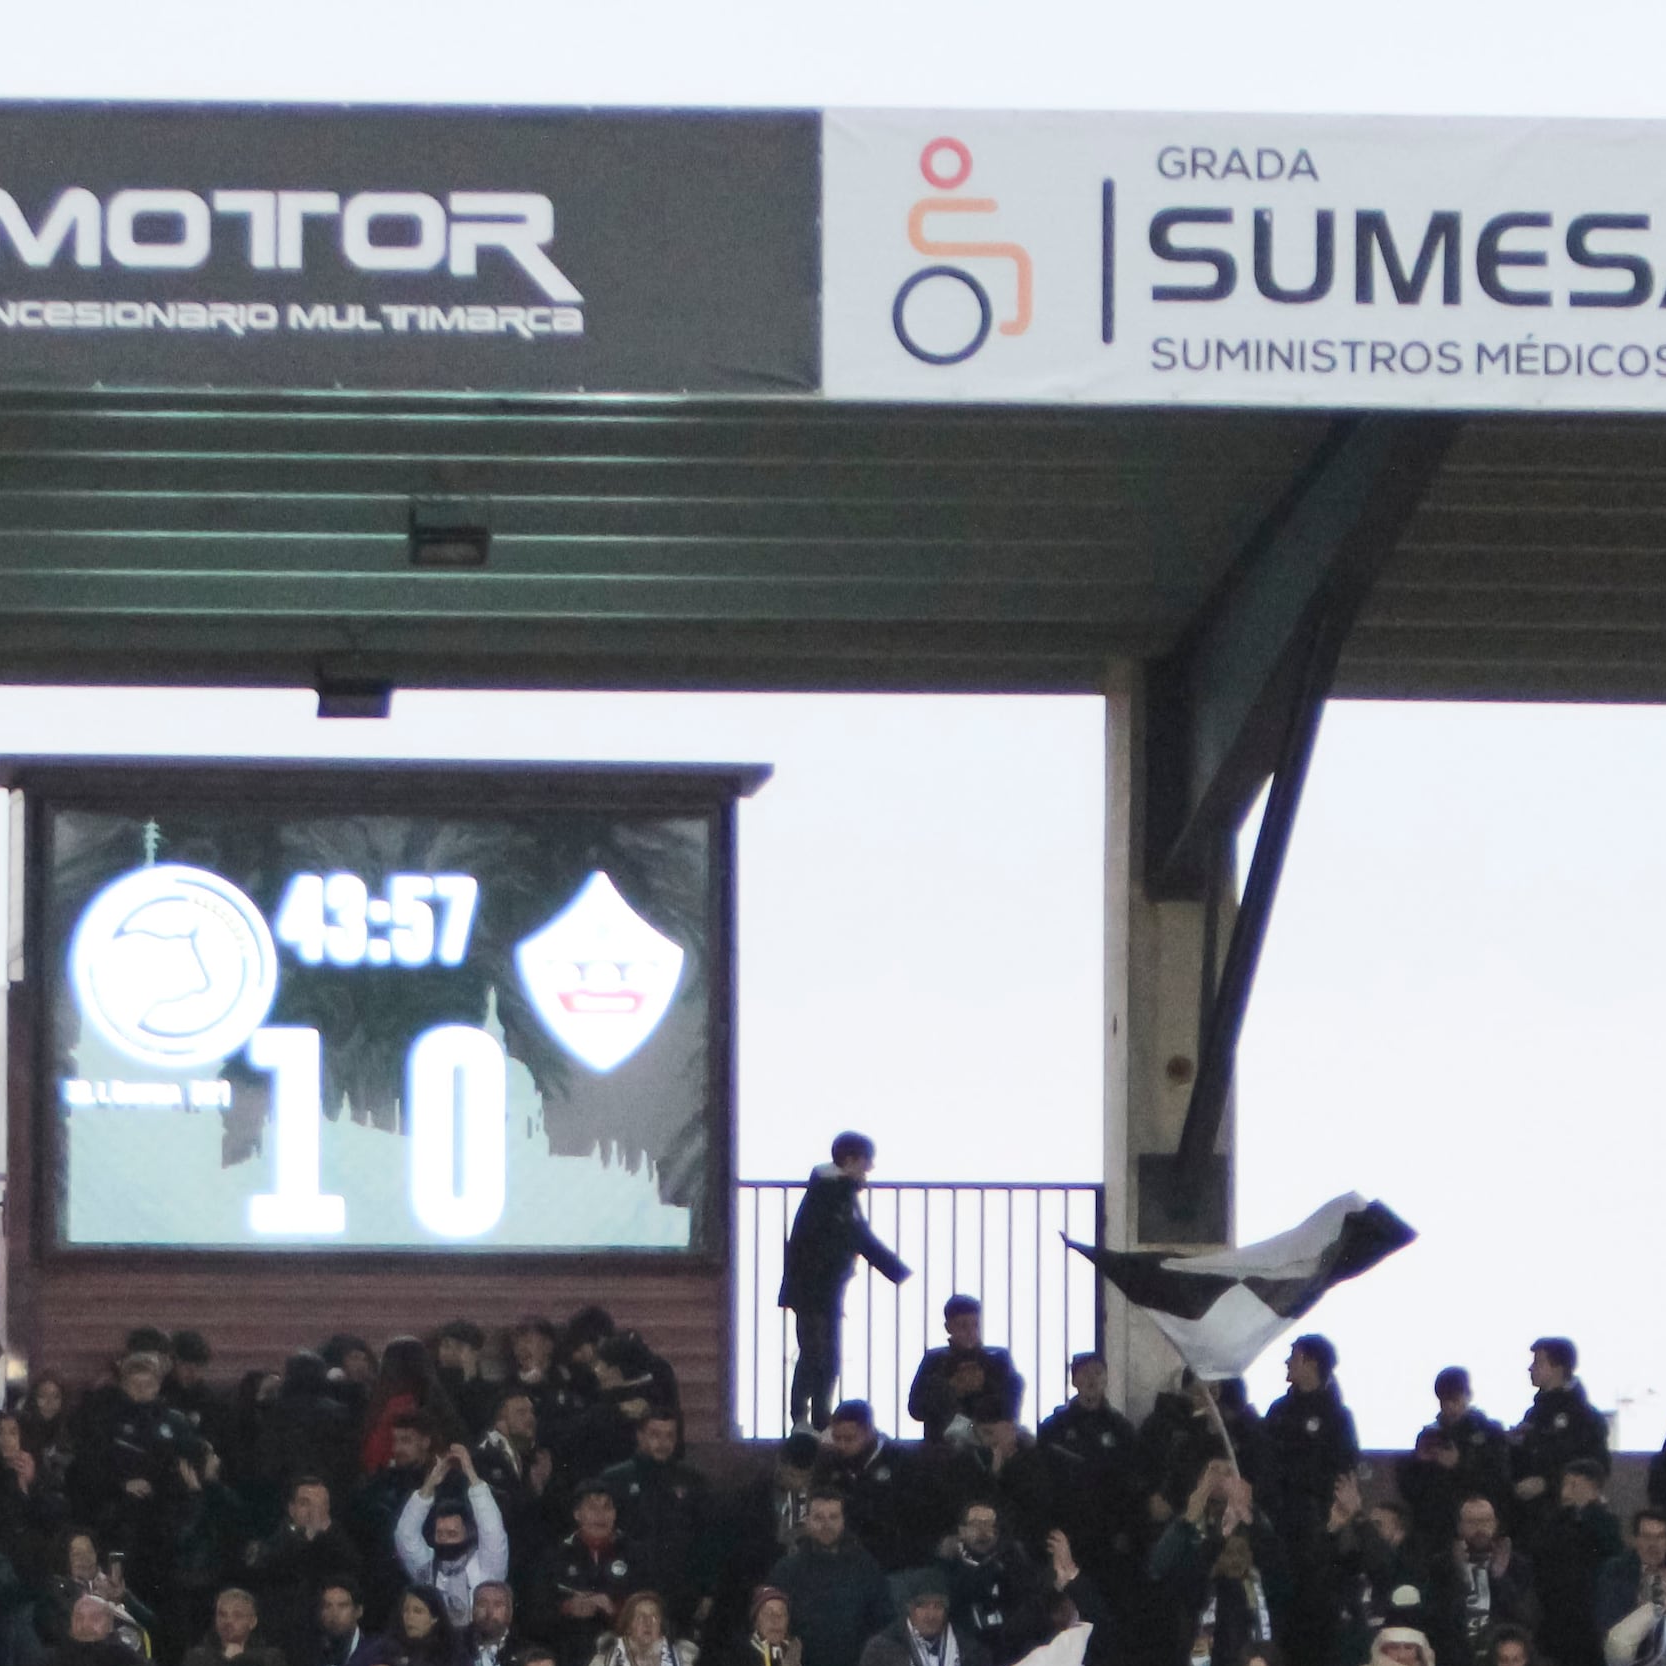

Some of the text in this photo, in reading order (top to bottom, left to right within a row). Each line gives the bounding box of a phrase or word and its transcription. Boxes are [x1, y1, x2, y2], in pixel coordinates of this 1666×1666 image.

[1157, 146, 1320, 184] GRADA
[1150, 336, 1463, 377] SUMINISTROS
[276, 873, 479, 966] 43:57
[247, 1024, 507, 1239] 1 0
